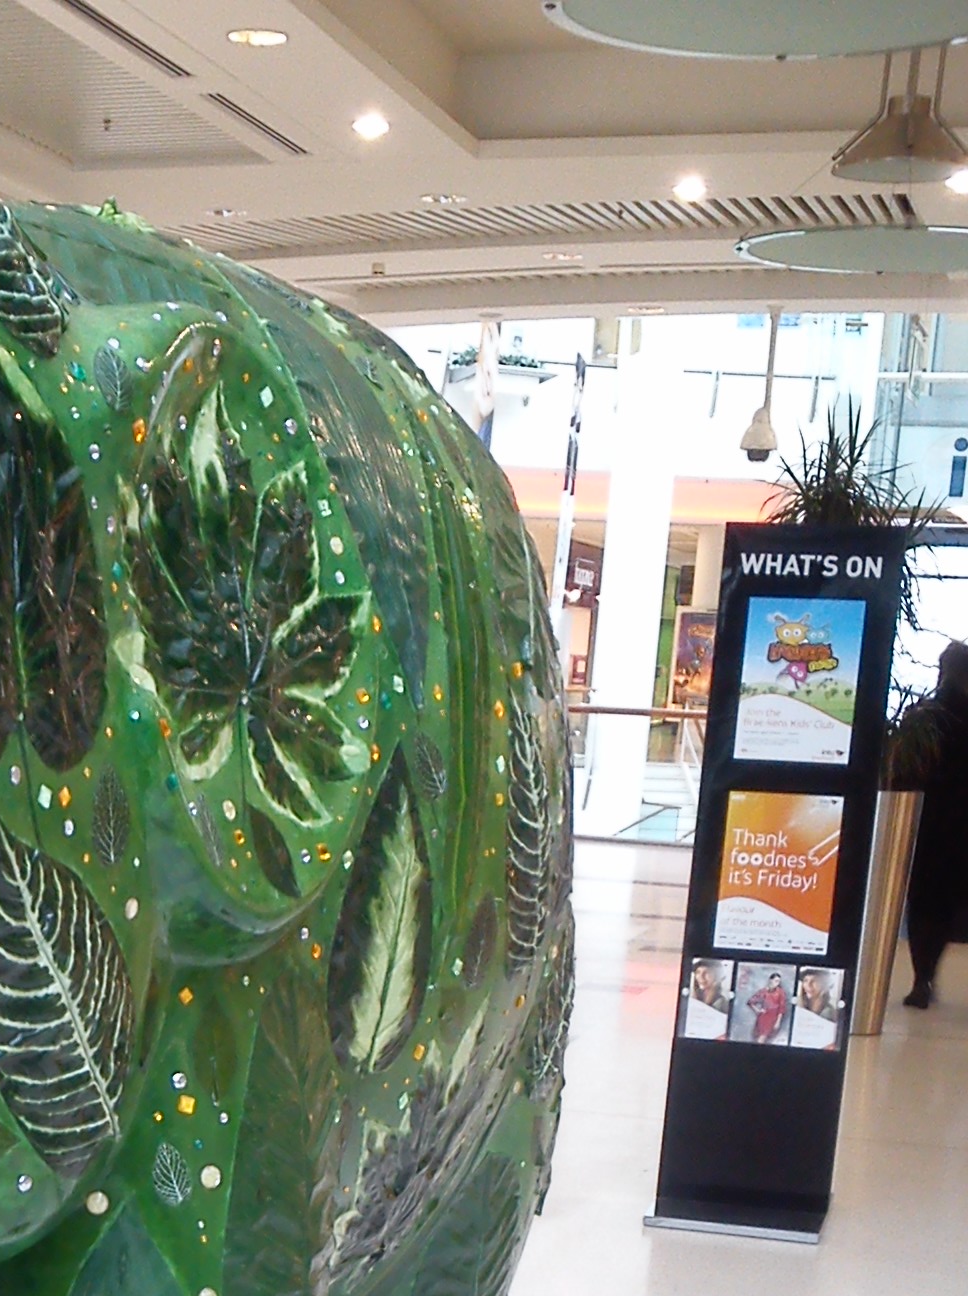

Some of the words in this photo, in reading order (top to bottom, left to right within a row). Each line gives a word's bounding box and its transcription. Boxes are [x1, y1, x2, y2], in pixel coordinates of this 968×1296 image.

[741, 552, 838, 577] WHAT'S
[846, 556, 883, 579] ON
[733, 828, 788, 848] Thank
[728, 868, 752, 884] it's
[757, 869, 817, 893] Friday!
[750, 919, 782, 929] month
